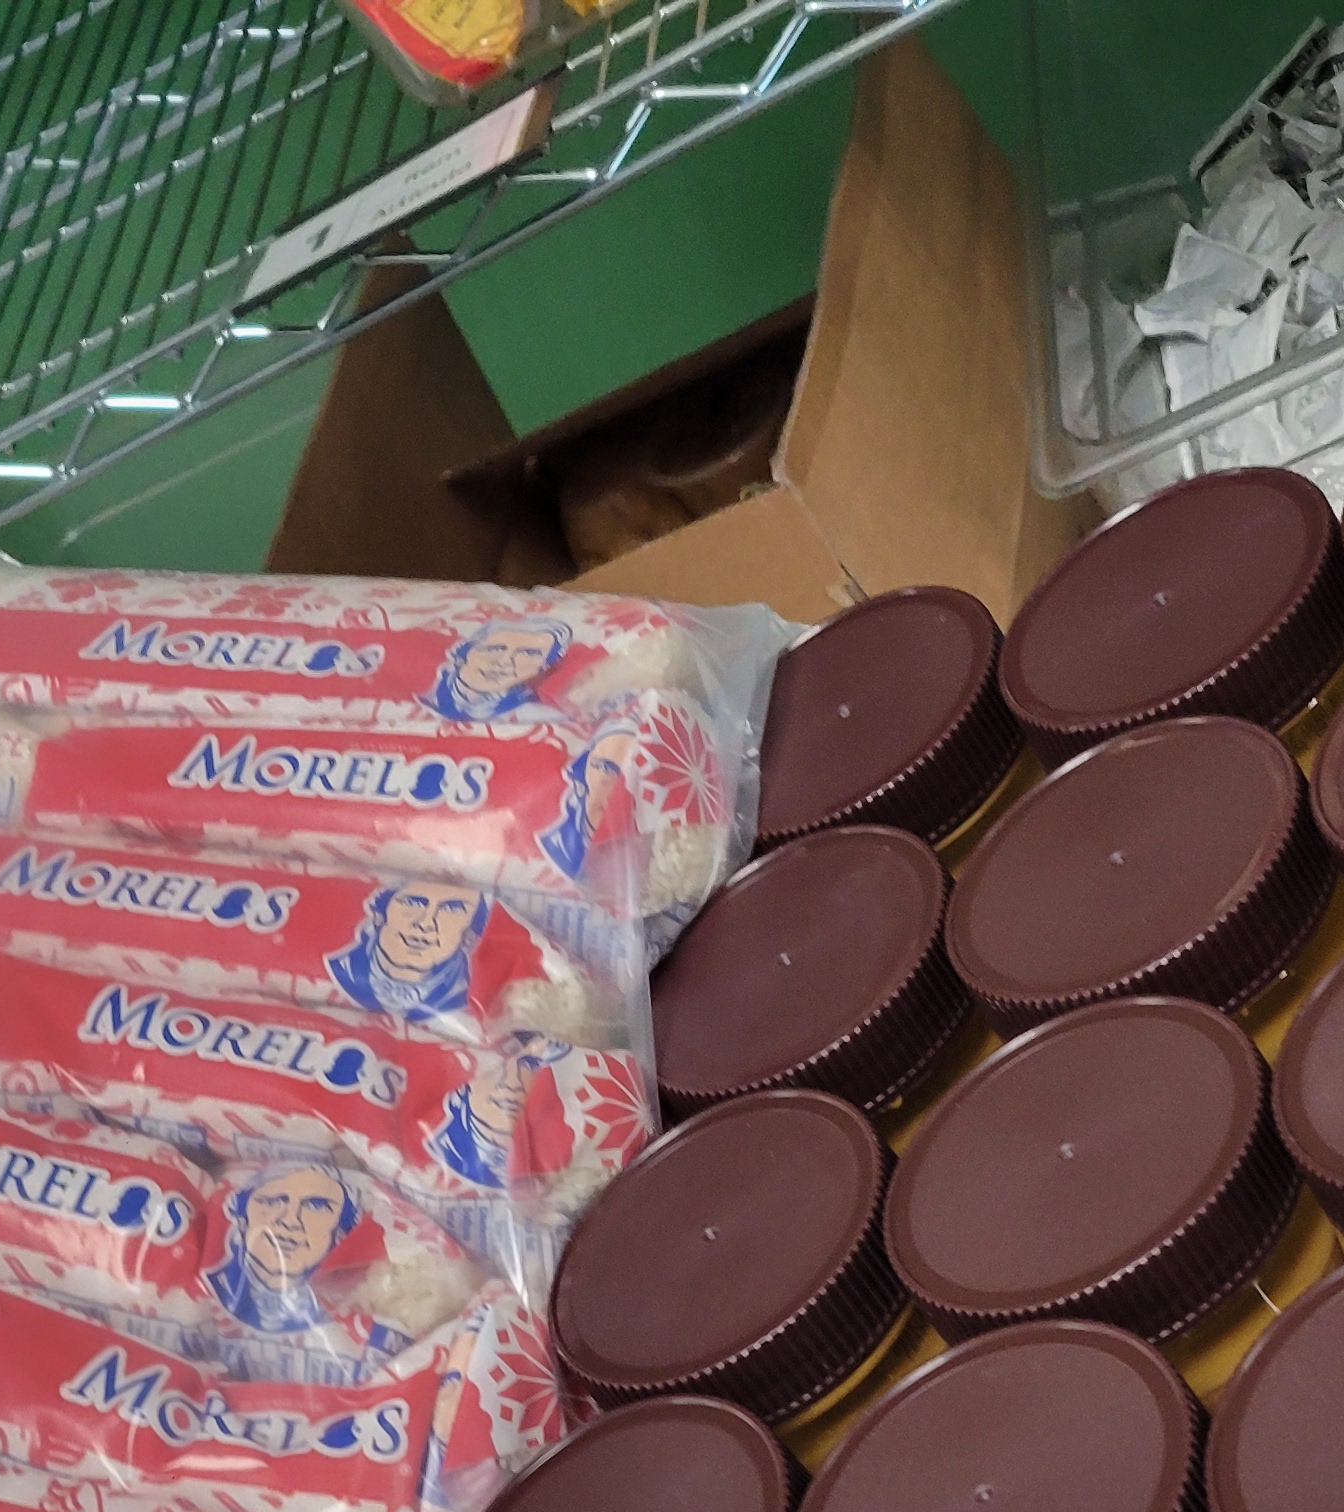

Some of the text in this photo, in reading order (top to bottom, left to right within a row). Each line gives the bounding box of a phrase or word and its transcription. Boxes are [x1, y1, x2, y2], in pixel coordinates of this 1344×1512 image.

[86, 620, 382, 676] MORELOS
[174, 735, 490, 806] MORELOS
[84, 985, 407, 1107] MORELOS
[67, 1350, 407, 1458] MORELOS
